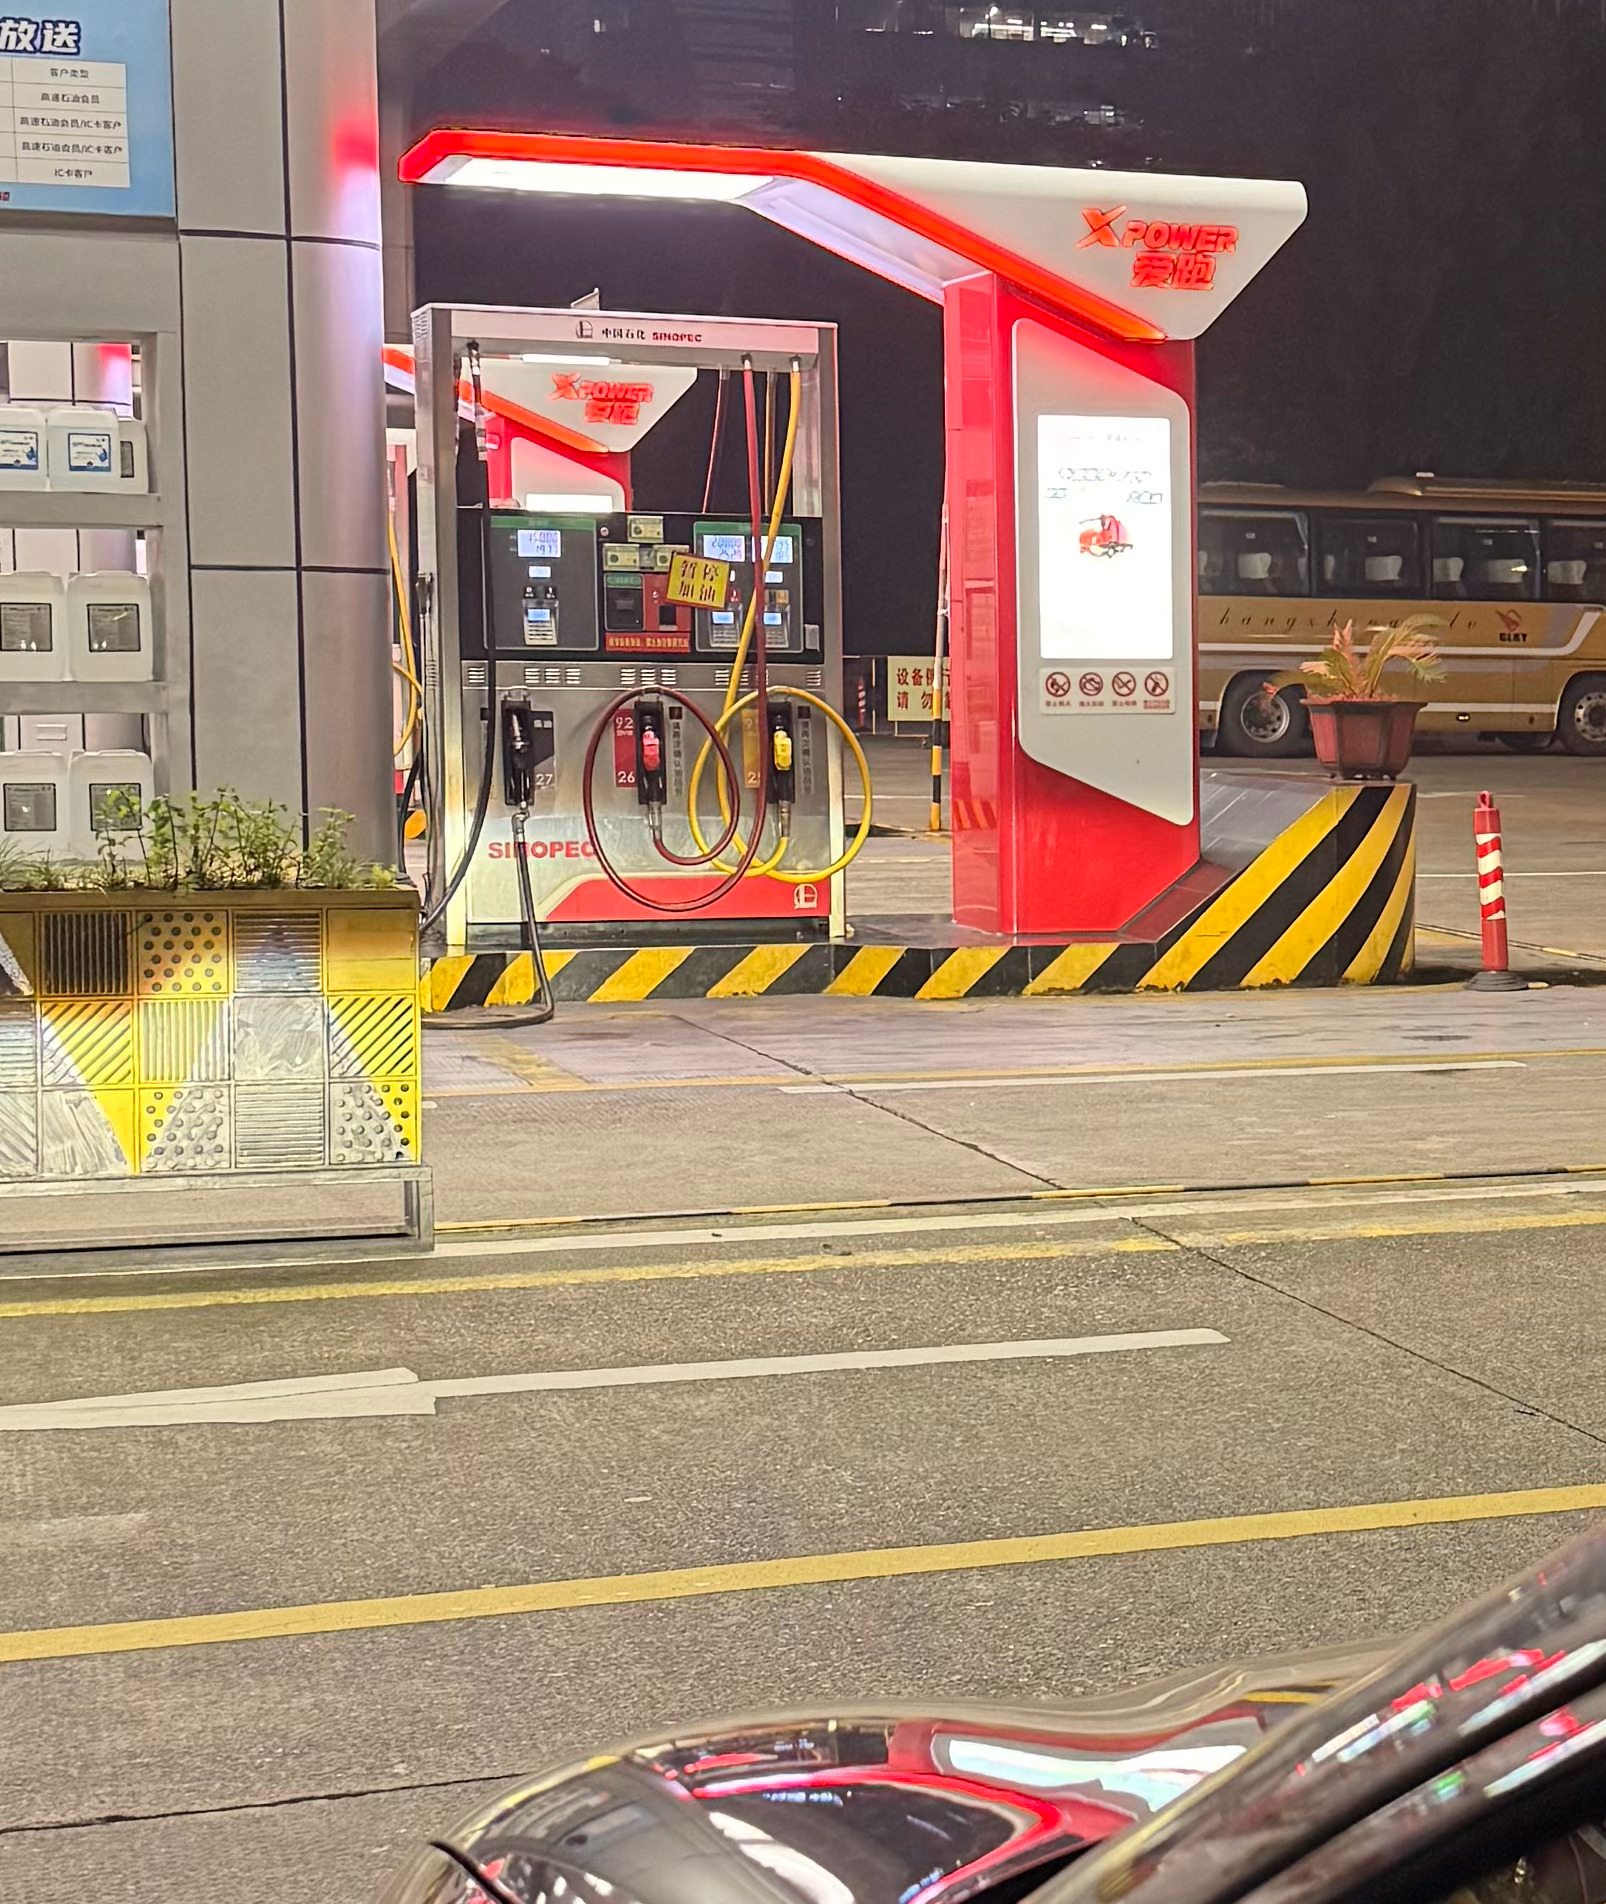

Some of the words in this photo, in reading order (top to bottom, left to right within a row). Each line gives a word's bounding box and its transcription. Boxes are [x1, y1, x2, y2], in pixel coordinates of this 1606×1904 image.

[0, 17, 81, 55] 放送
[1130, 250, 1217, 291] 爱跑
[652, 331, 702, 342] SINOPEC
[615, 716, 634, 729] 92
[535, 773, 553, 786] 27
[617, 770, 636, 783] 26
[488, 841, 597, 859] SIOPEC
